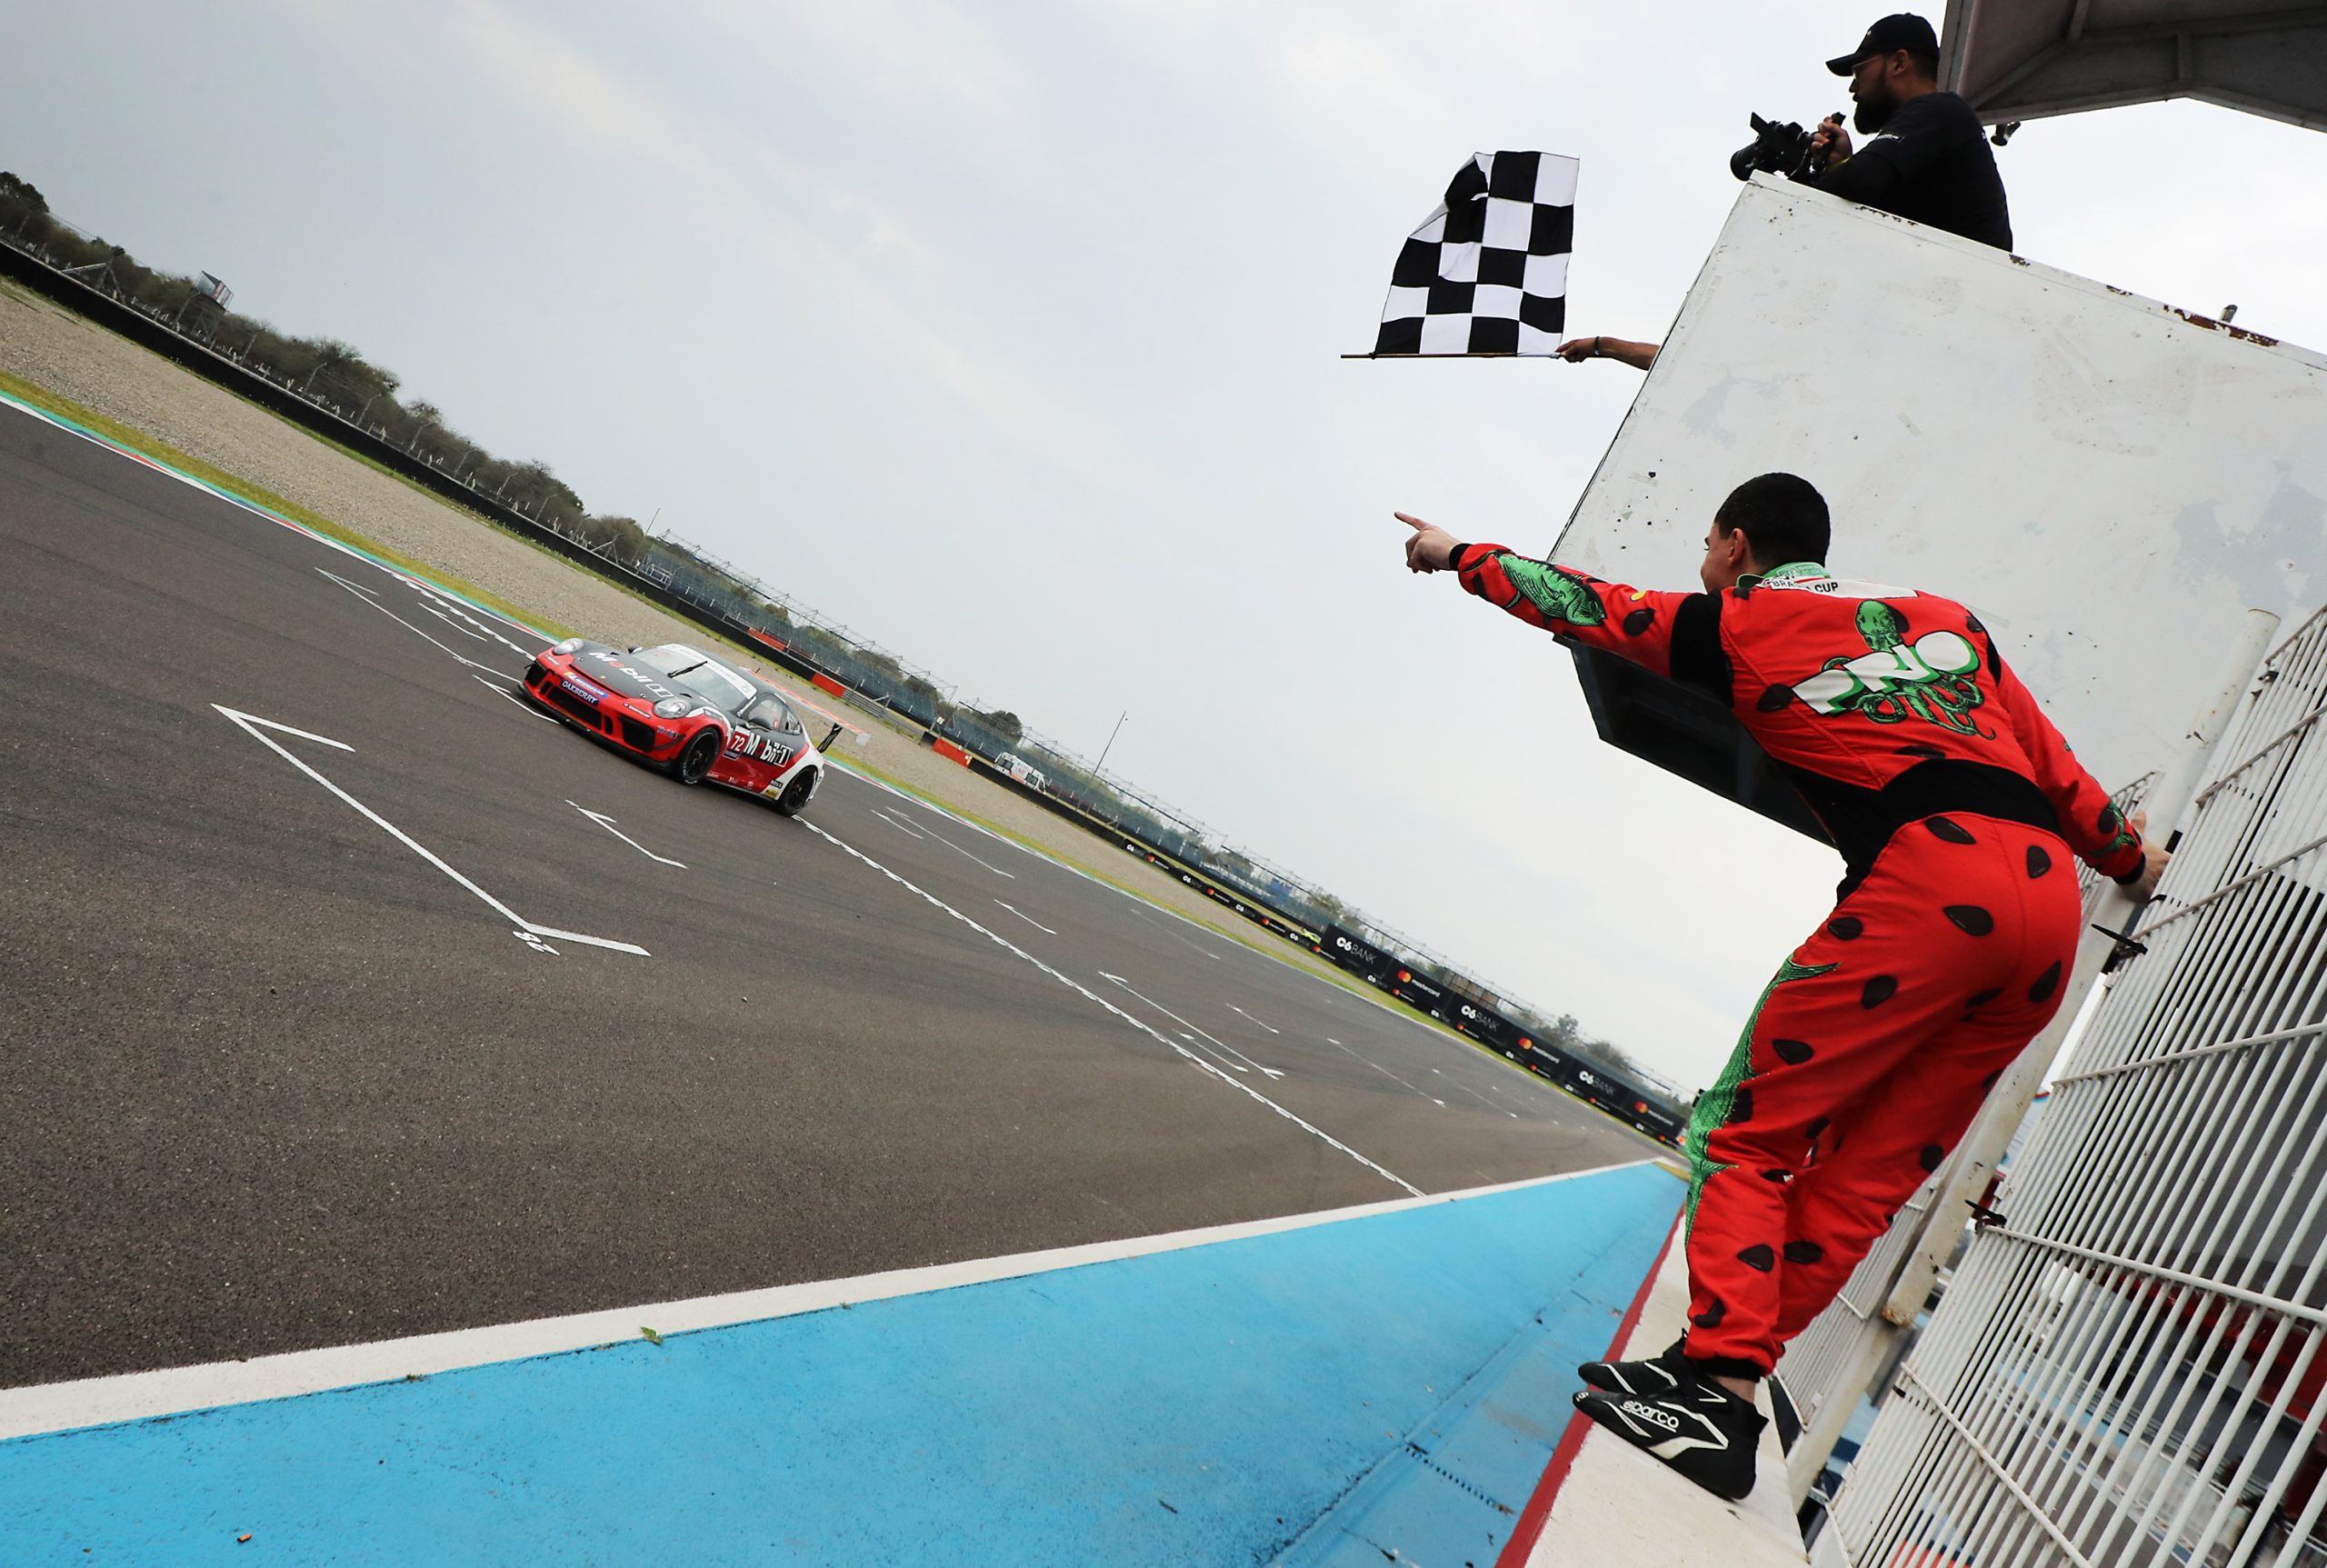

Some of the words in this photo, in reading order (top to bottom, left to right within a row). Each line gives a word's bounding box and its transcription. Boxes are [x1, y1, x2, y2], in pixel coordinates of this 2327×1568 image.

[1814, 582, 1839, 593] CUP
[589, 652, 654, 683] Mobil
[562, 680, 599, 704] OAKBERRY
[730, 734, 745, 752] 72
[1622, 1400, 1680, 1429] sparco
